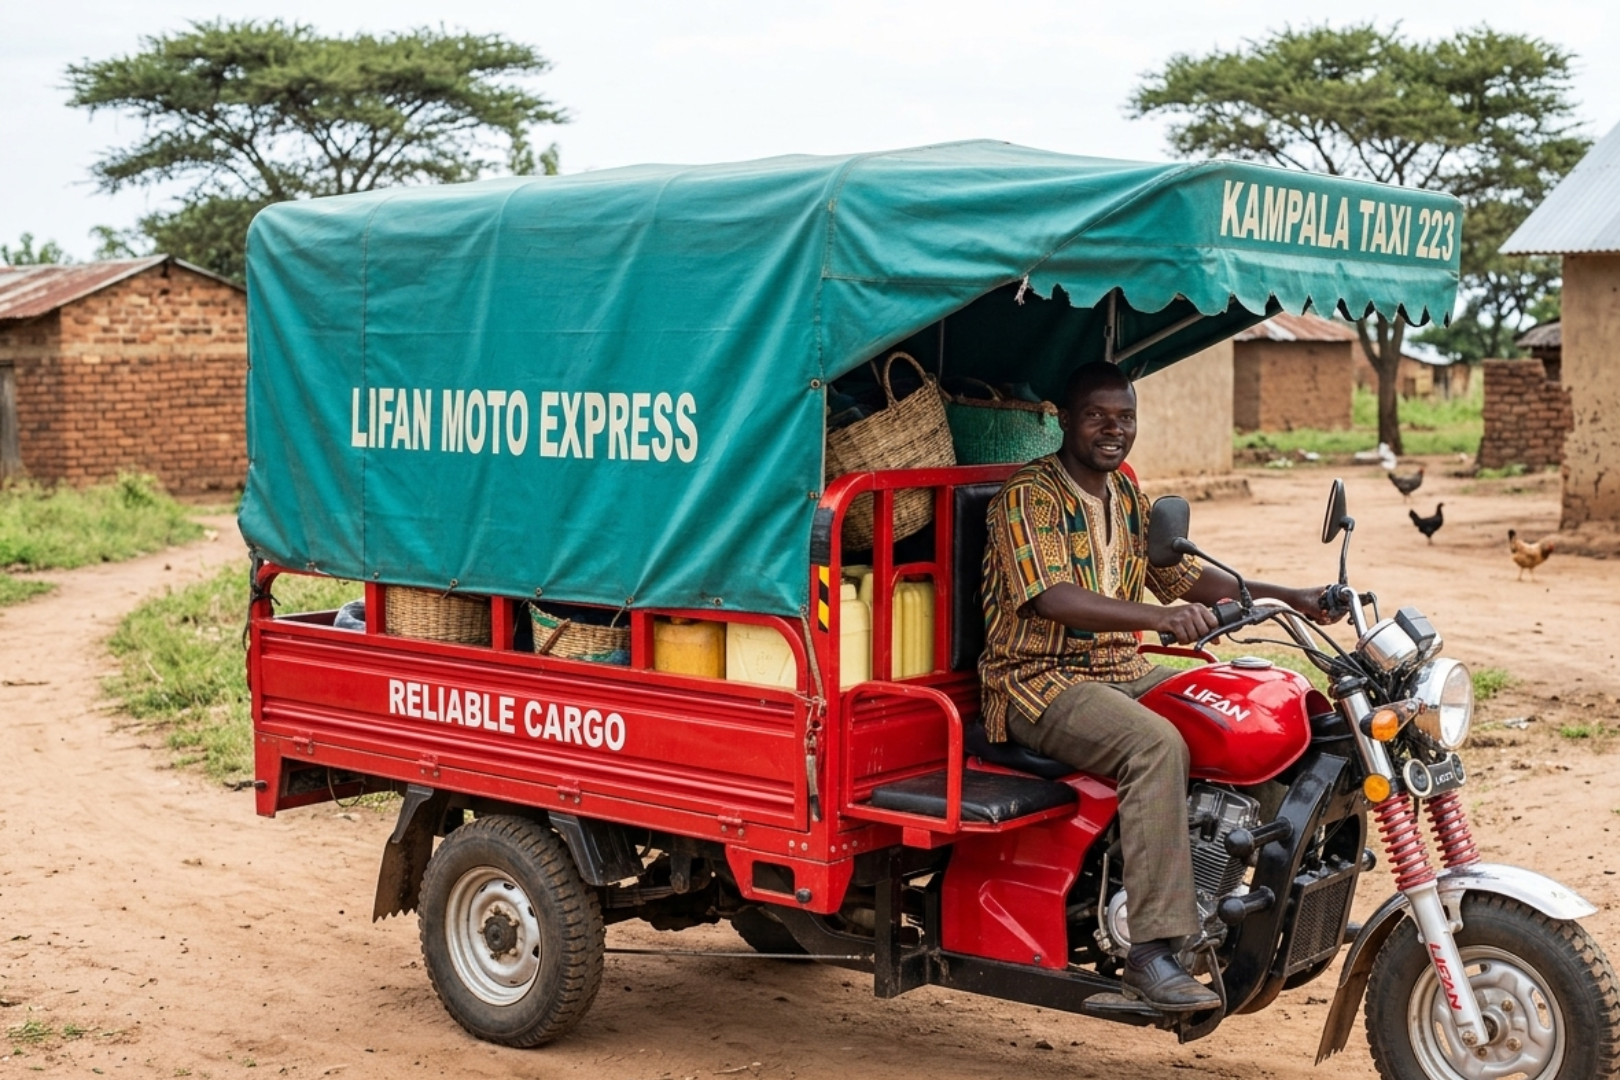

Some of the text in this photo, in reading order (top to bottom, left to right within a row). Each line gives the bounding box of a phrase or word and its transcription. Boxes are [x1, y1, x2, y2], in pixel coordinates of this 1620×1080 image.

[1220, 180, 1454, 262] KAMPALA TAXI 223
[351, 388, 698, 463] LIFAN MOTO EXPRESS
[389, 679, 626, 751] RELIABLE CARGO
[1183, 684, 1251, 721] LIFAN
